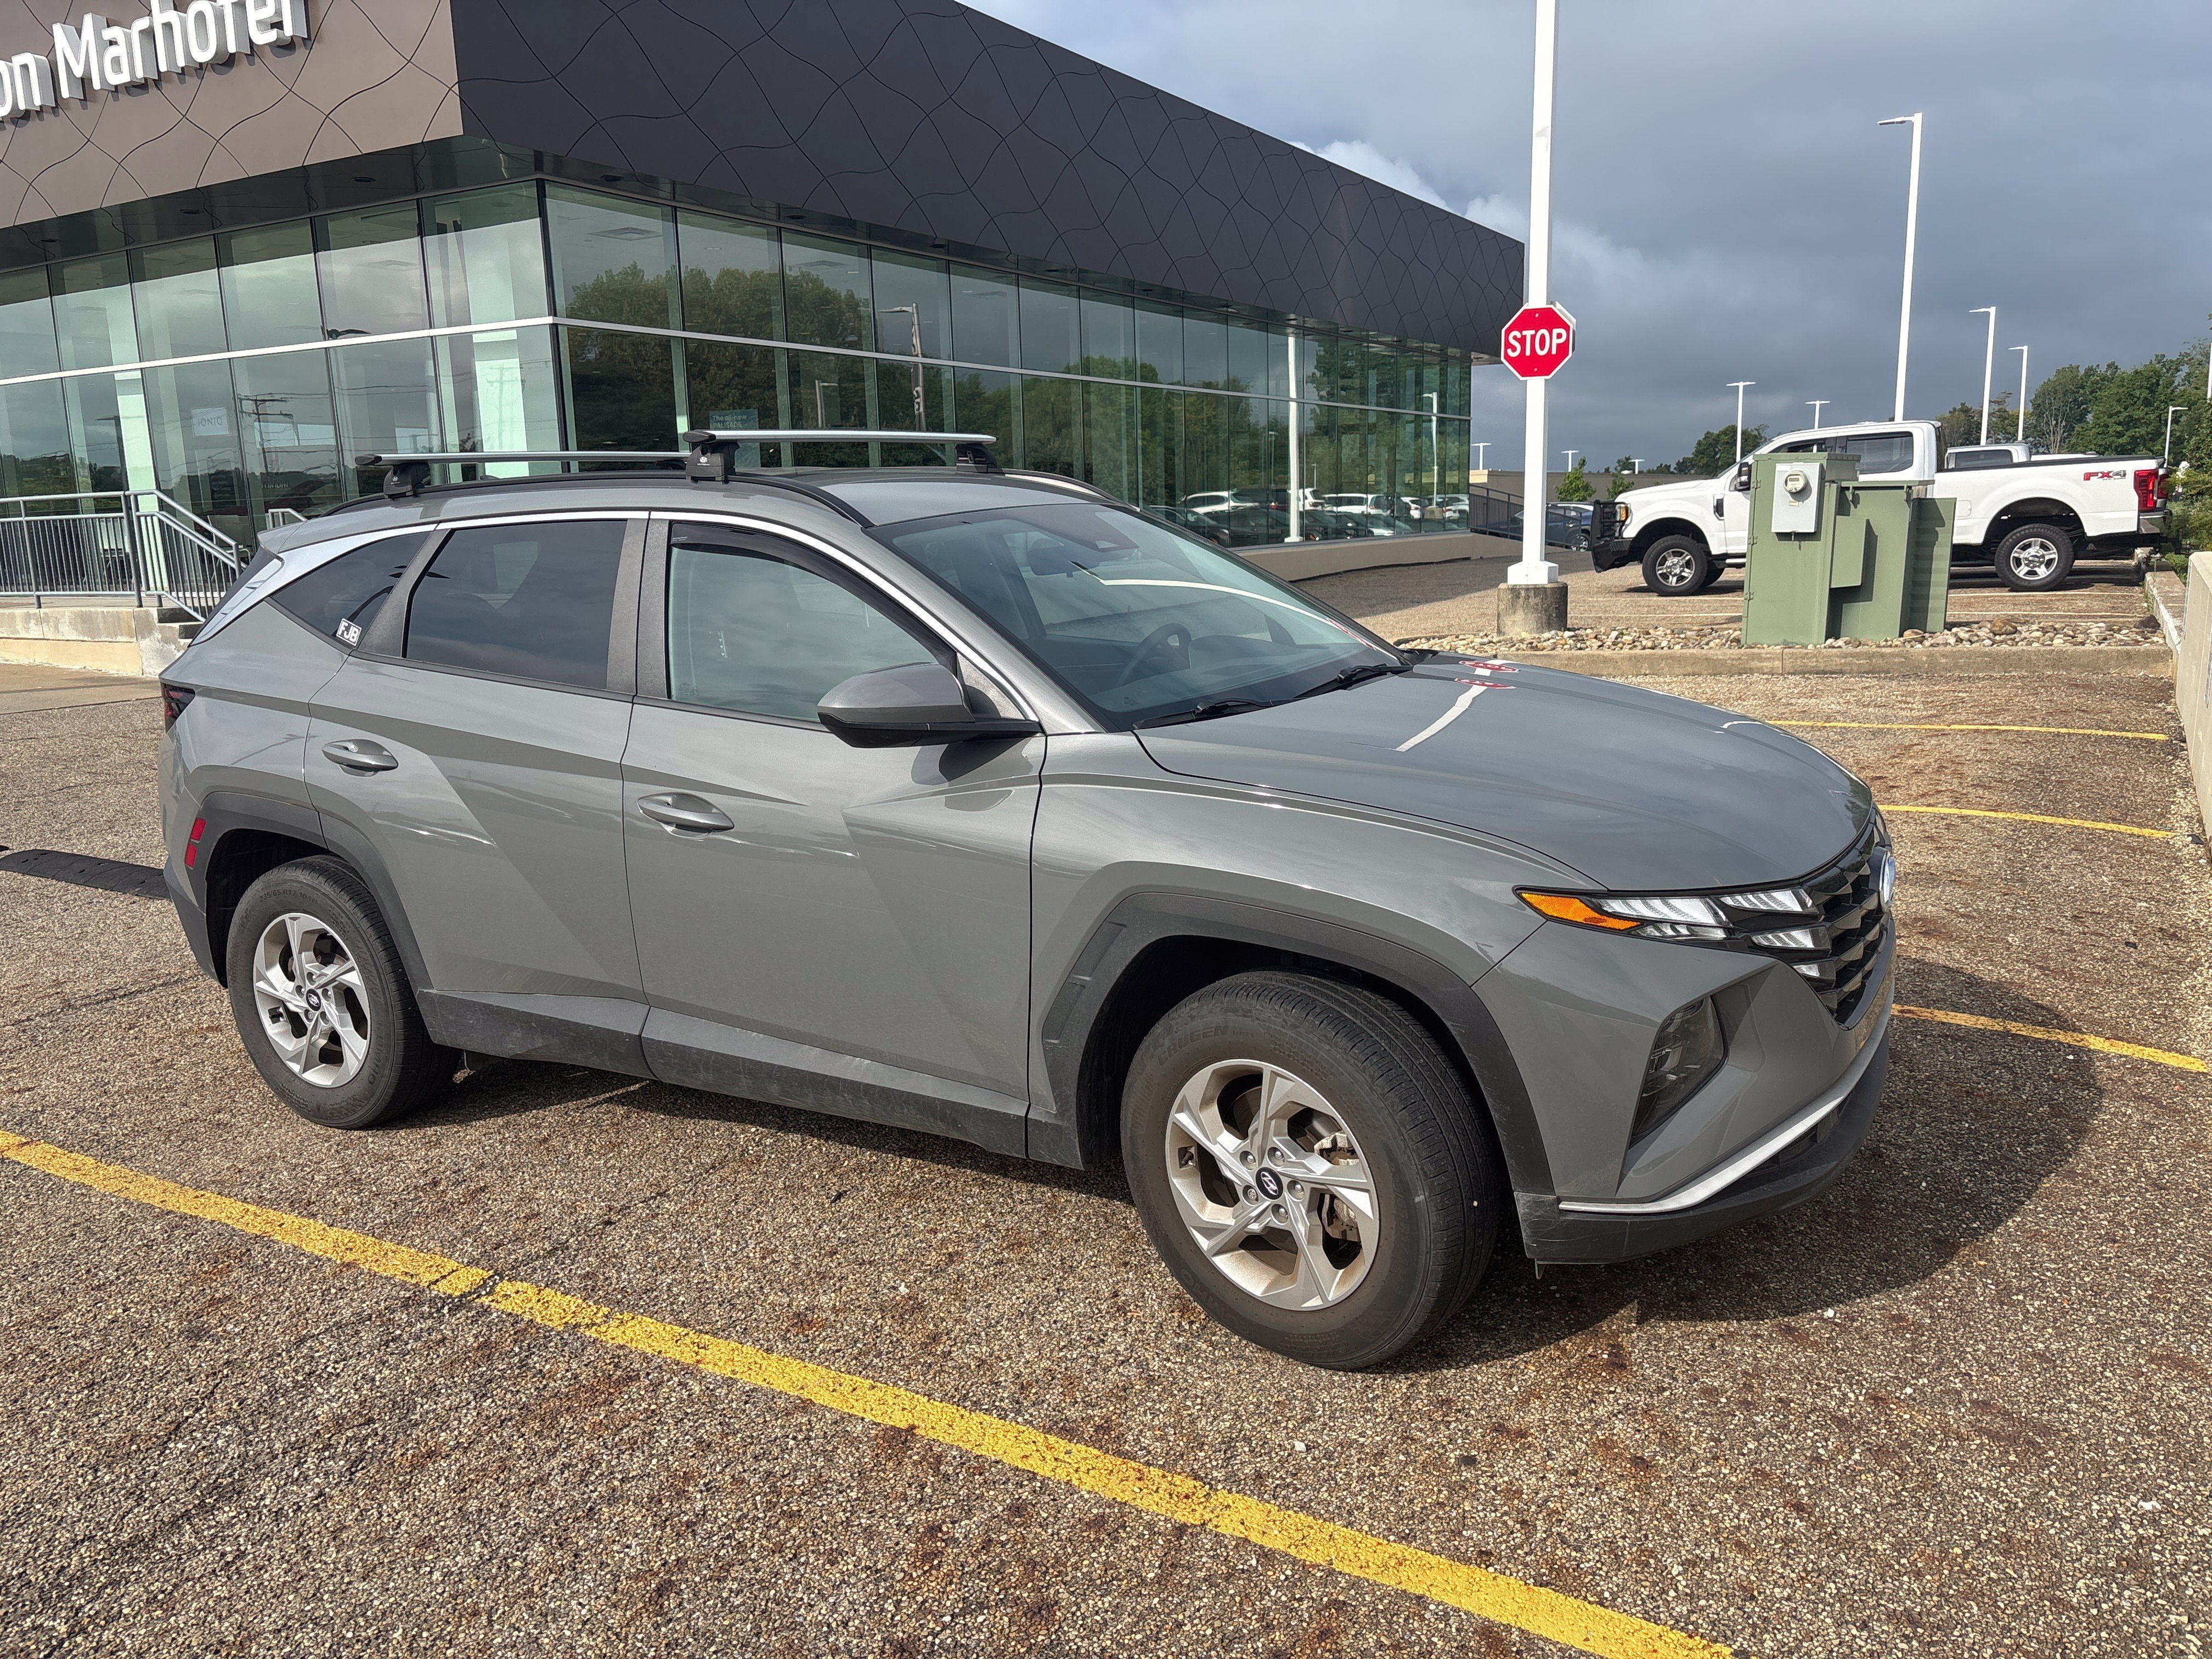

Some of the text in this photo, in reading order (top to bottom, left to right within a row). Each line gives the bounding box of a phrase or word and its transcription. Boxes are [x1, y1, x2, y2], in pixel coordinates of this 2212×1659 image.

[1507, 328, 1567, 357] STOP
[2083, 470, 2126, 481] FX4
[338, 621, 359, 642] FJB
[1157, 1025, 1229, 1066] CRUGEN
